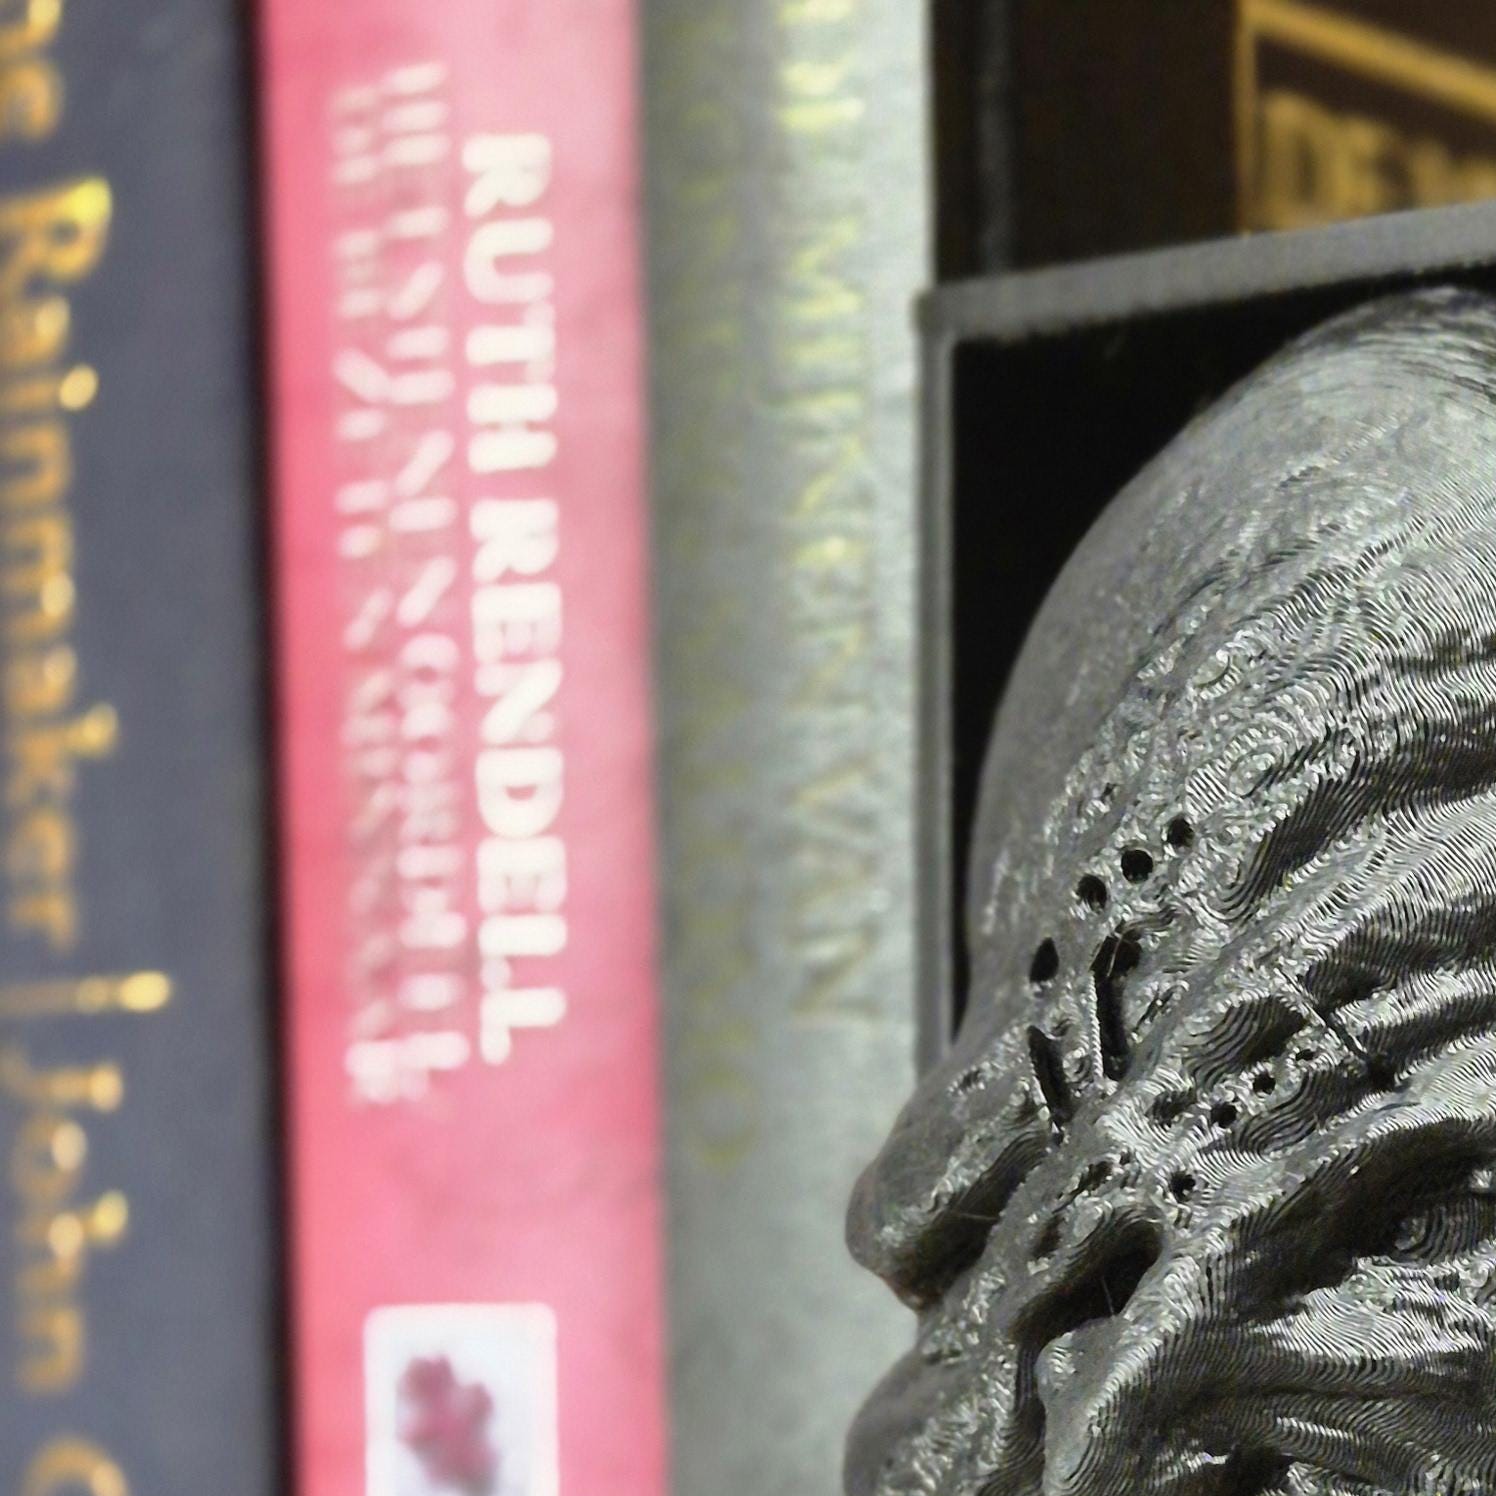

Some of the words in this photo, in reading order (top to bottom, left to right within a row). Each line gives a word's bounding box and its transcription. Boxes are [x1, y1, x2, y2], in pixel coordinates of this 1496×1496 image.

[462, 132, 560, 476] RUTH
[469, 497, 568, 1066] RENDELL
[0, 1048, 130, 1398] John
